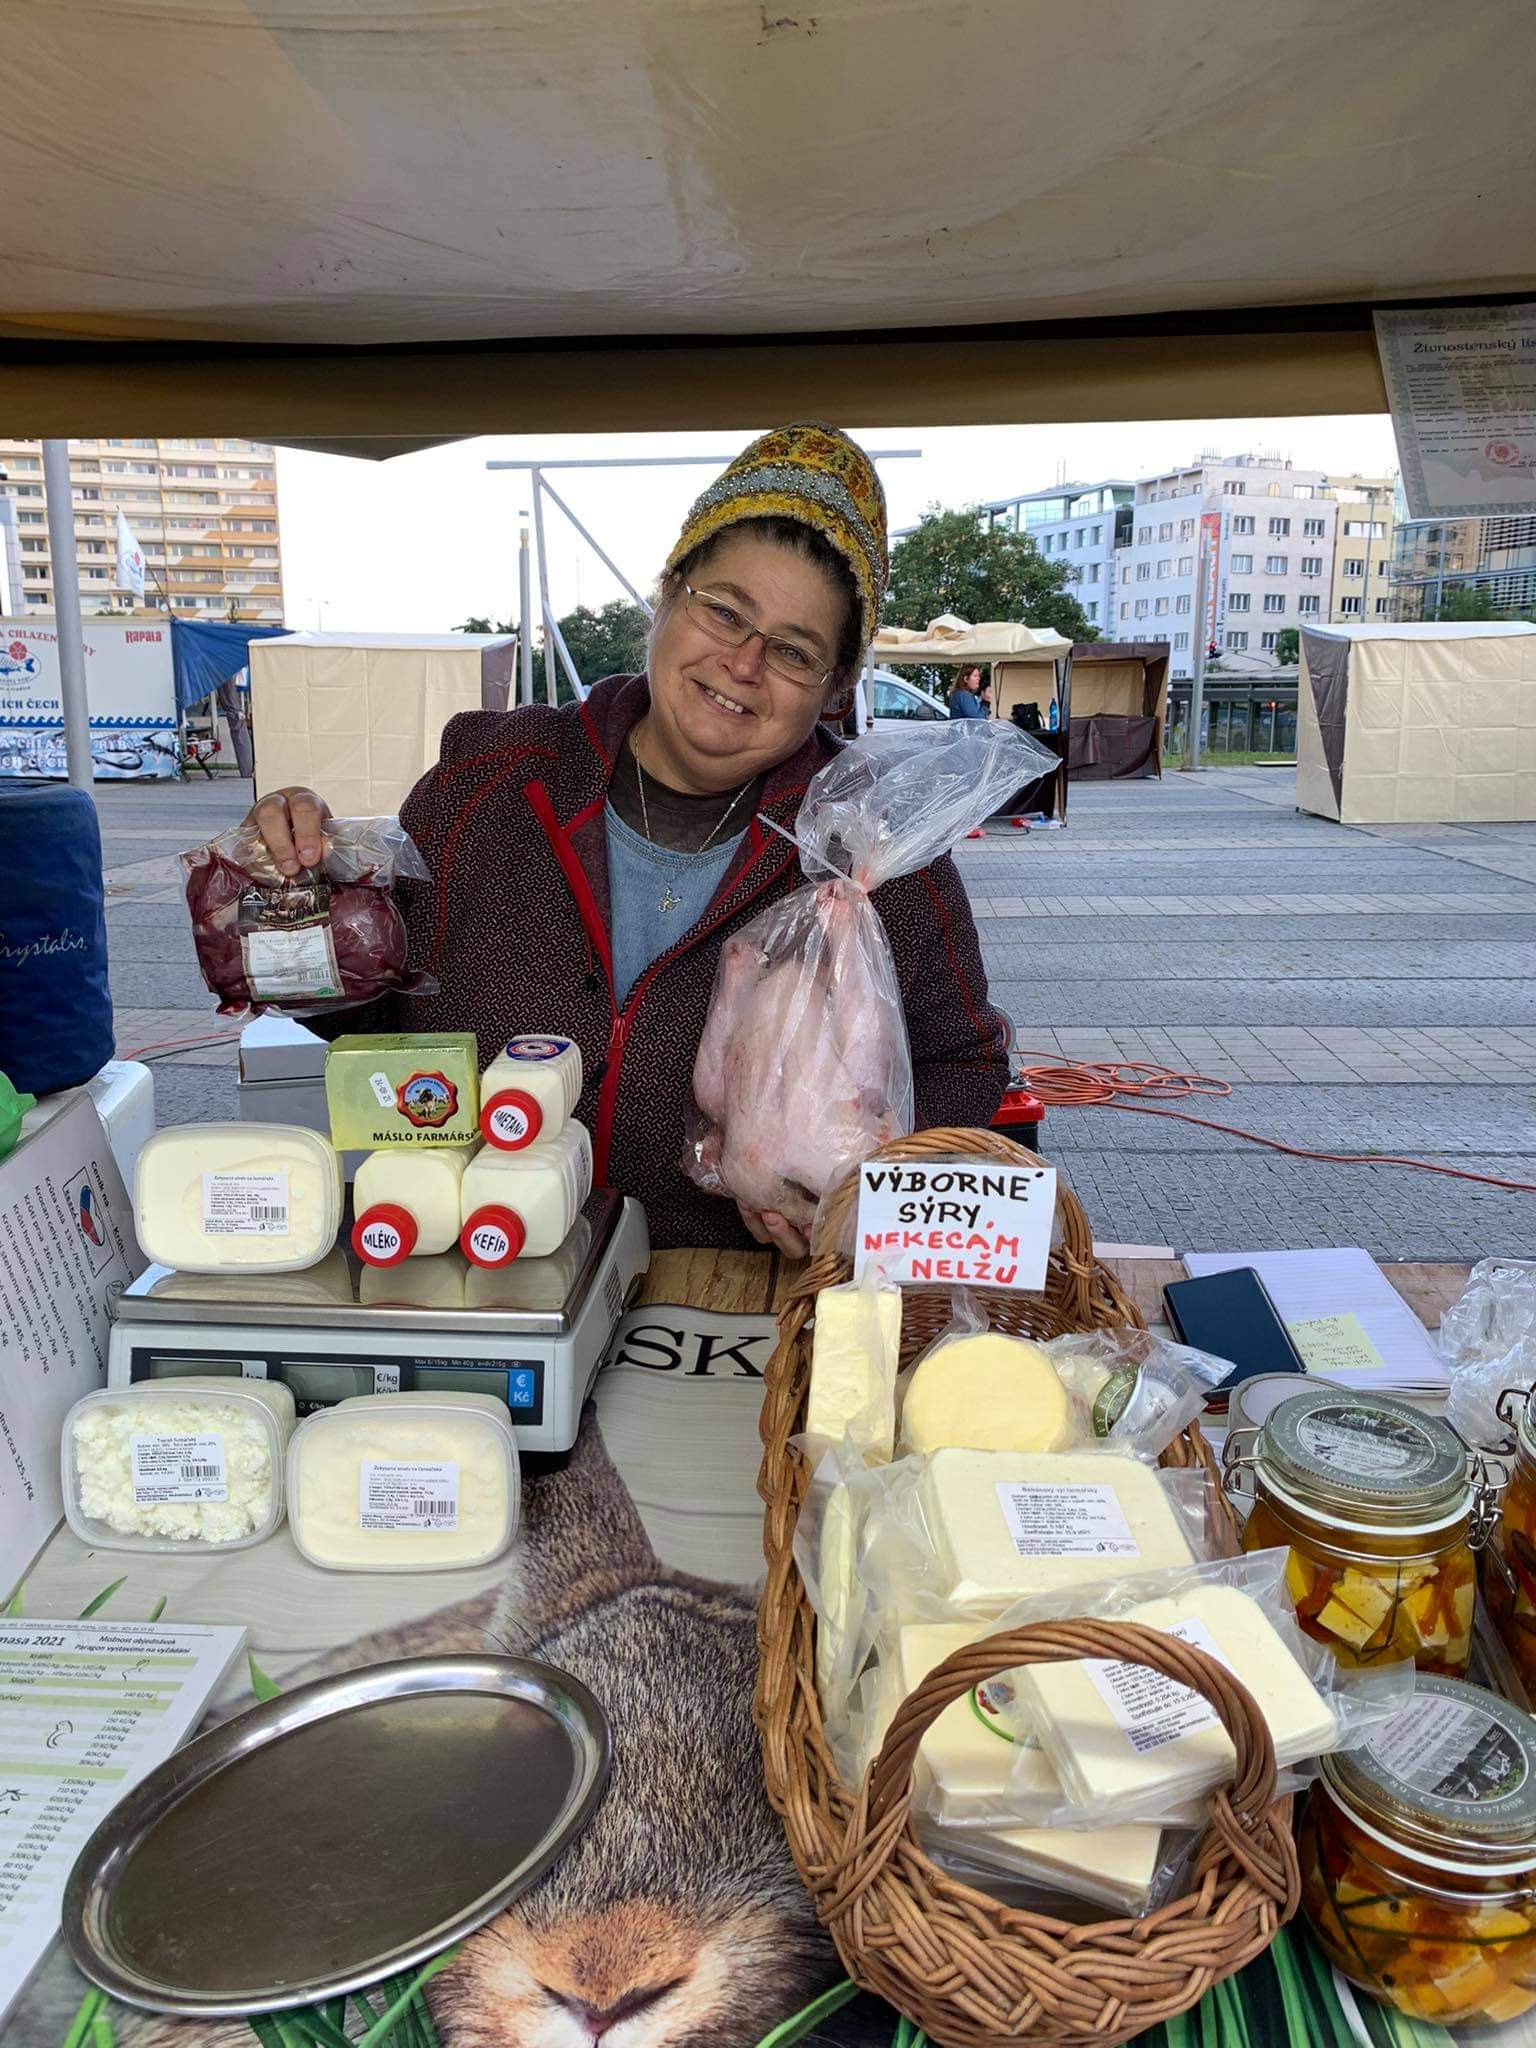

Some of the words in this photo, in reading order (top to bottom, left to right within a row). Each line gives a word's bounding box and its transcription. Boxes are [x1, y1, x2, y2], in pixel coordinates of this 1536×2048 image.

[1521, 337, 1536, 349] lis
[8, 629, 59, 643] CHLAZEN
[26, 697, 60, 710] ČECH
[493, 1109, 525, 1136] SMETANA
[372, 1129, 413, 1142] MÁSLO
[416, 1129, 475, 1142] FARMÁRS
[45, 1176, 58, 1204] Krůta
[91, 1160, 105, 1191] Ceník
[102, 1193, 110, 1208] na
[865, 1165, 1045, 1202] VÝBORNÉ
[23, 1194, 38, 1221] Krůtí
[32, 1220, 45, 1243] prsa
[898, 1195, 981, 1229] SÝRY
[12, 1203, 25, 1230] Krůtí
[22, 1229, 37, 1258] horní
[33, 1257, 50, 1293] stehno
[34, 1184, 51, 1220] Krocan
[47, 1221, 58, 1241] celý
[55, 1241, 66, 1259] bez
[62, 1260, 77, 1290] drobů
[363, 1229, 398, 1249] MLÉKO
[473, 1231, 507, 1252] KEFÍR
[864, 1220, 1021, 1258] NEKECÁM
[1, 1213, 15, 1240] Krůtí
[11, 1240, 29, 1275] spodní
[25, 1275, 42, 1311] stehno
[911, 1252, 1019, 1285] NELŽU
[2, 1293, 16, 1321] maso
[376, 1372, 398, 1385] €/kg
[515, 1374, 527, 1388] €
[513, 1391, 531, 1403] Kč
[32, 1636, 66, 1647] 2021
[74, 1644, 106, 1653] Paragon
[99, 1635, 133, 1643] Možnost
[133, 1637, 177, 1646] objednávek
